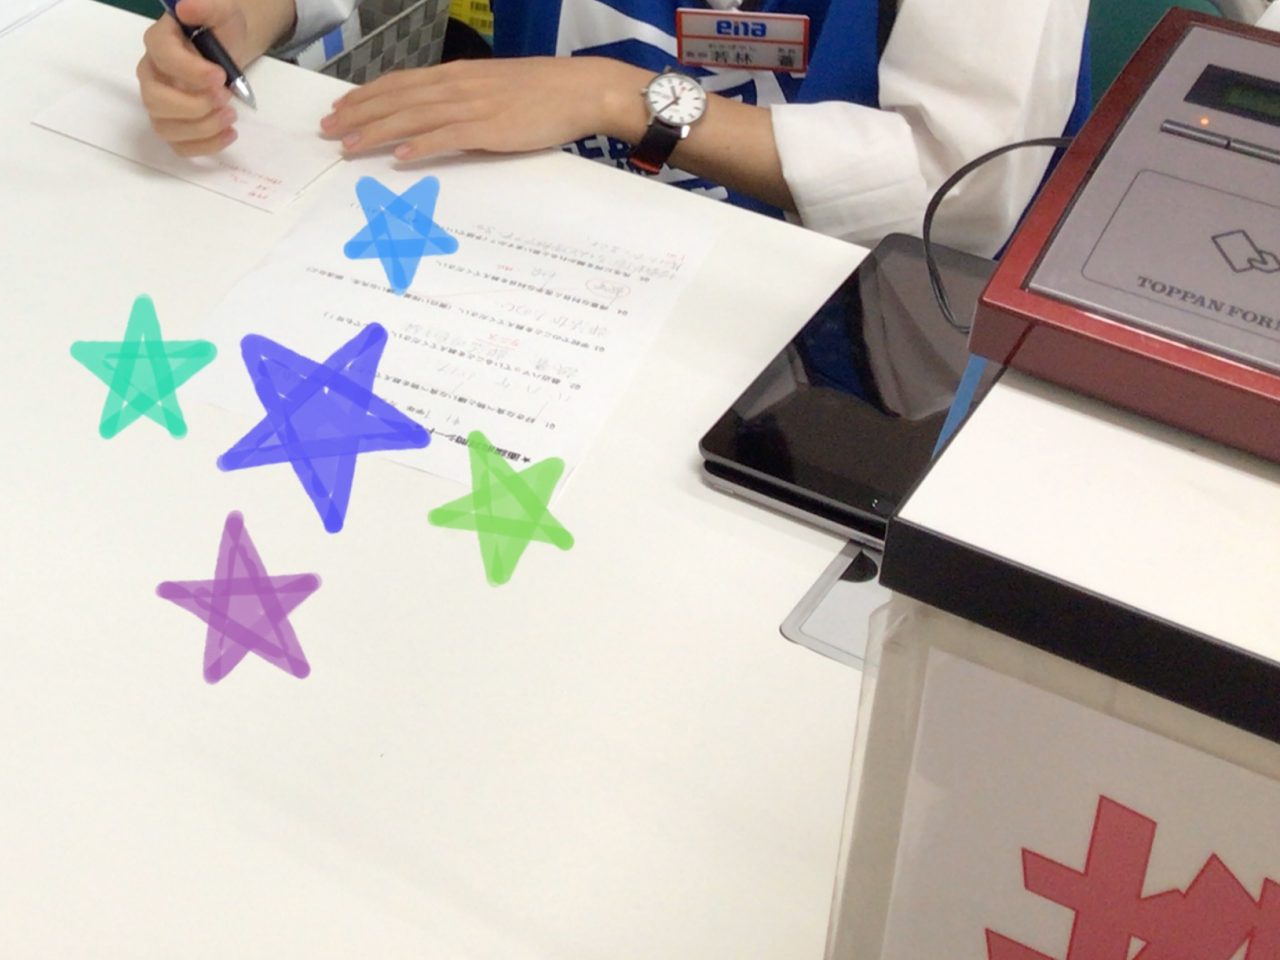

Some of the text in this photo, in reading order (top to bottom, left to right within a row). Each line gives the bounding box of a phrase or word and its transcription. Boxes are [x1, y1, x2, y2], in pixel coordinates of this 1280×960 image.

[716, 20, 767, 37] ena
[1138, 276, 1280, 330] TOPPAN FOR
